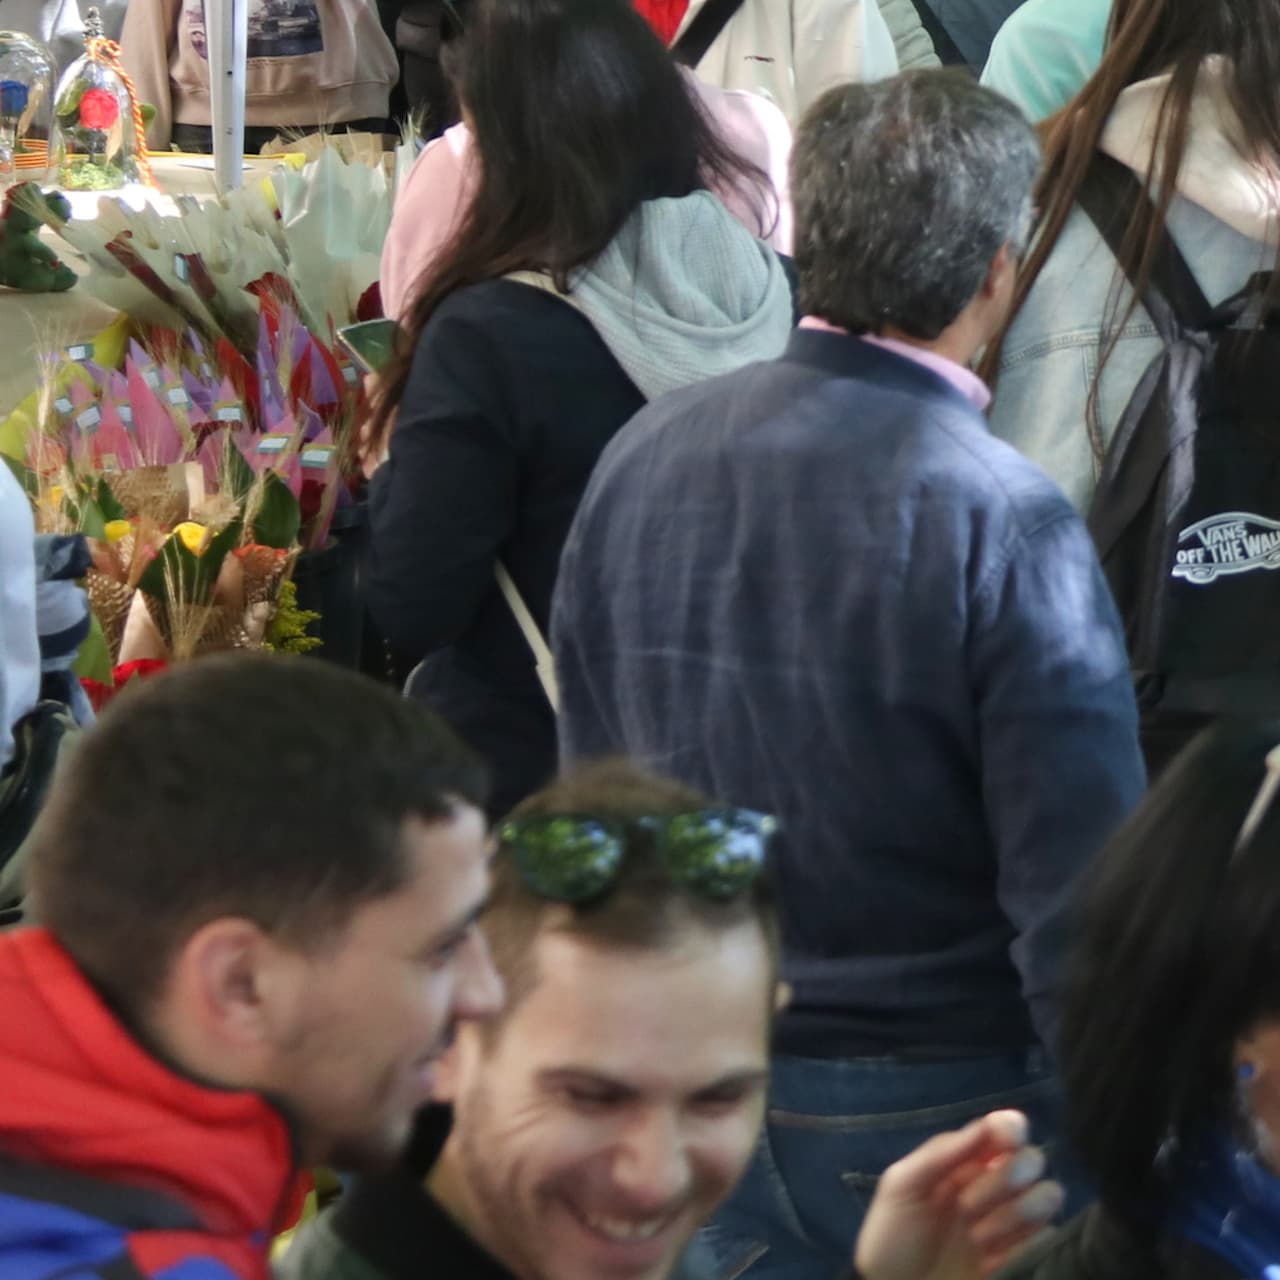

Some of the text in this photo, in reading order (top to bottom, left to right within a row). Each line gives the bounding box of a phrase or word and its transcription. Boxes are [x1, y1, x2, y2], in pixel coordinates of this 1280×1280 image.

[1196, 521, 1248, 546] VANS
[1176, 547, 1205, 563] OFF
[1206, 540, 1246, 563] THE
